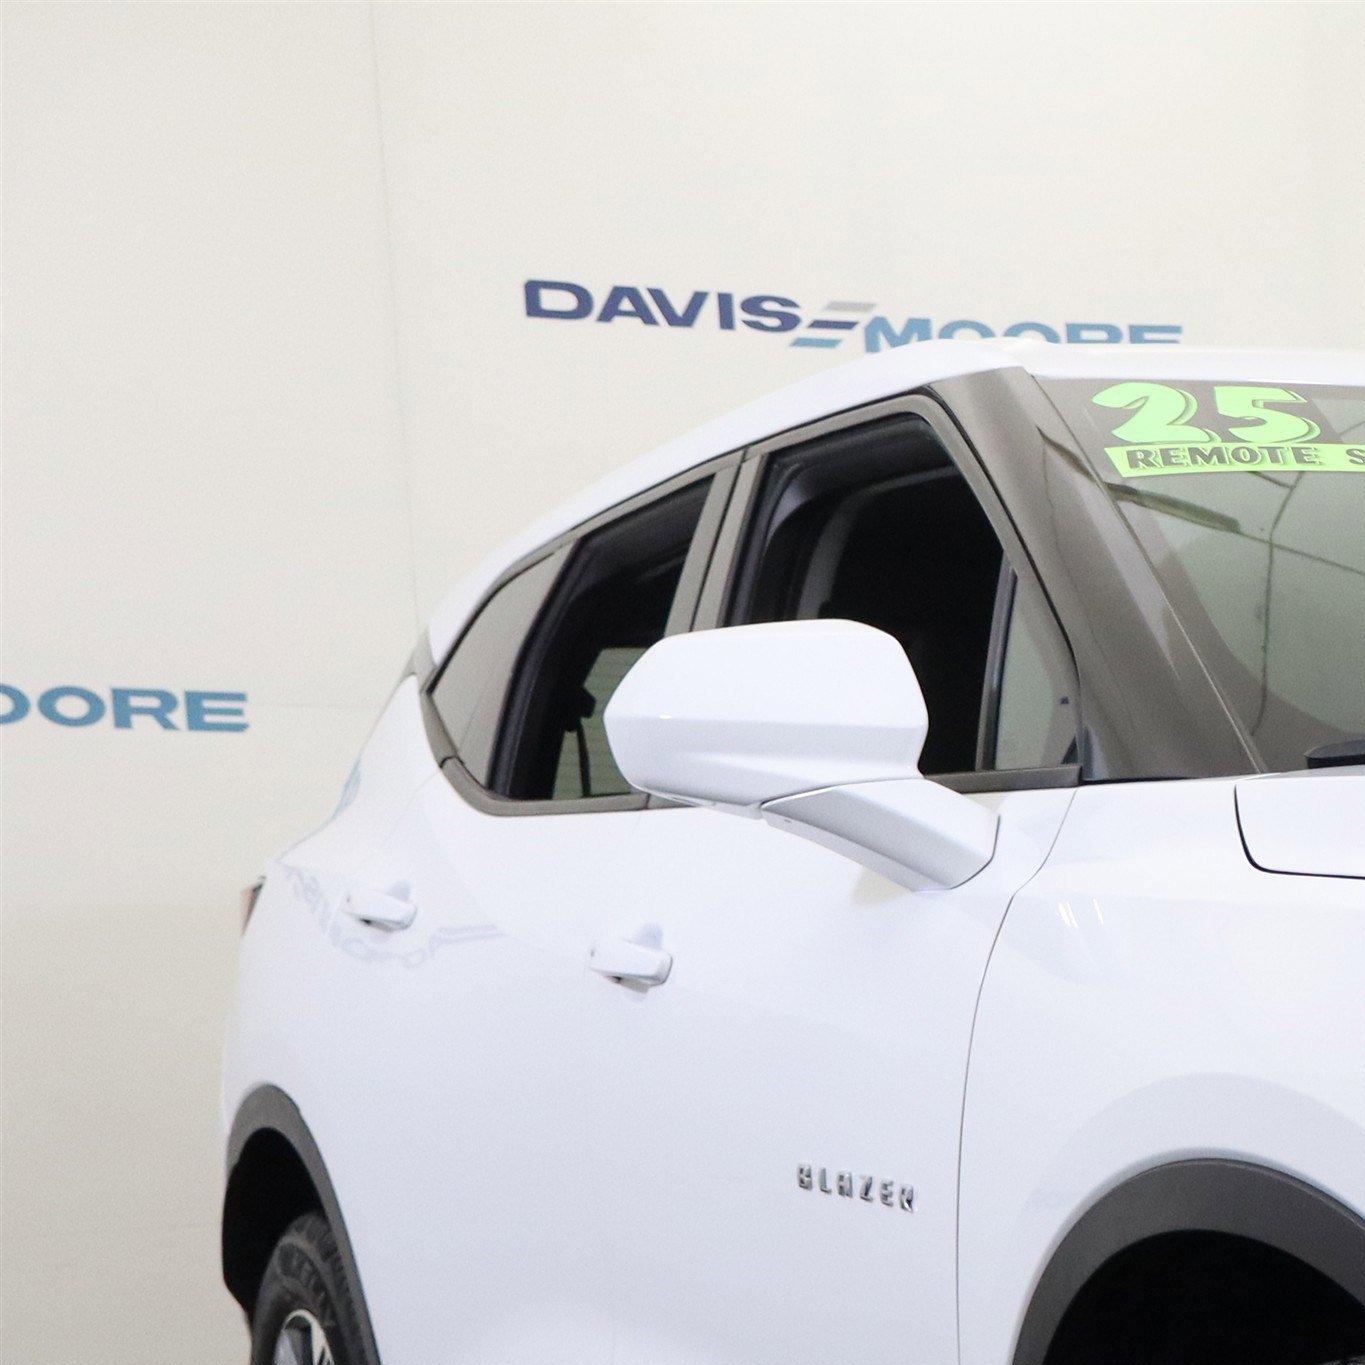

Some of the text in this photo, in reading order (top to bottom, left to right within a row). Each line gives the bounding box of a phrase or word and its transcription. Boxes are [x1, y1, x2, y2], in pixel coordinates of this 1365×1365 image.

[523, 279, 802, 332] DAVIS
[1092, 381, 1321, 444] 25
[1126, 445, 1321, 470] REMOTE
[797, 1163, 917, 1213] BLAZER
